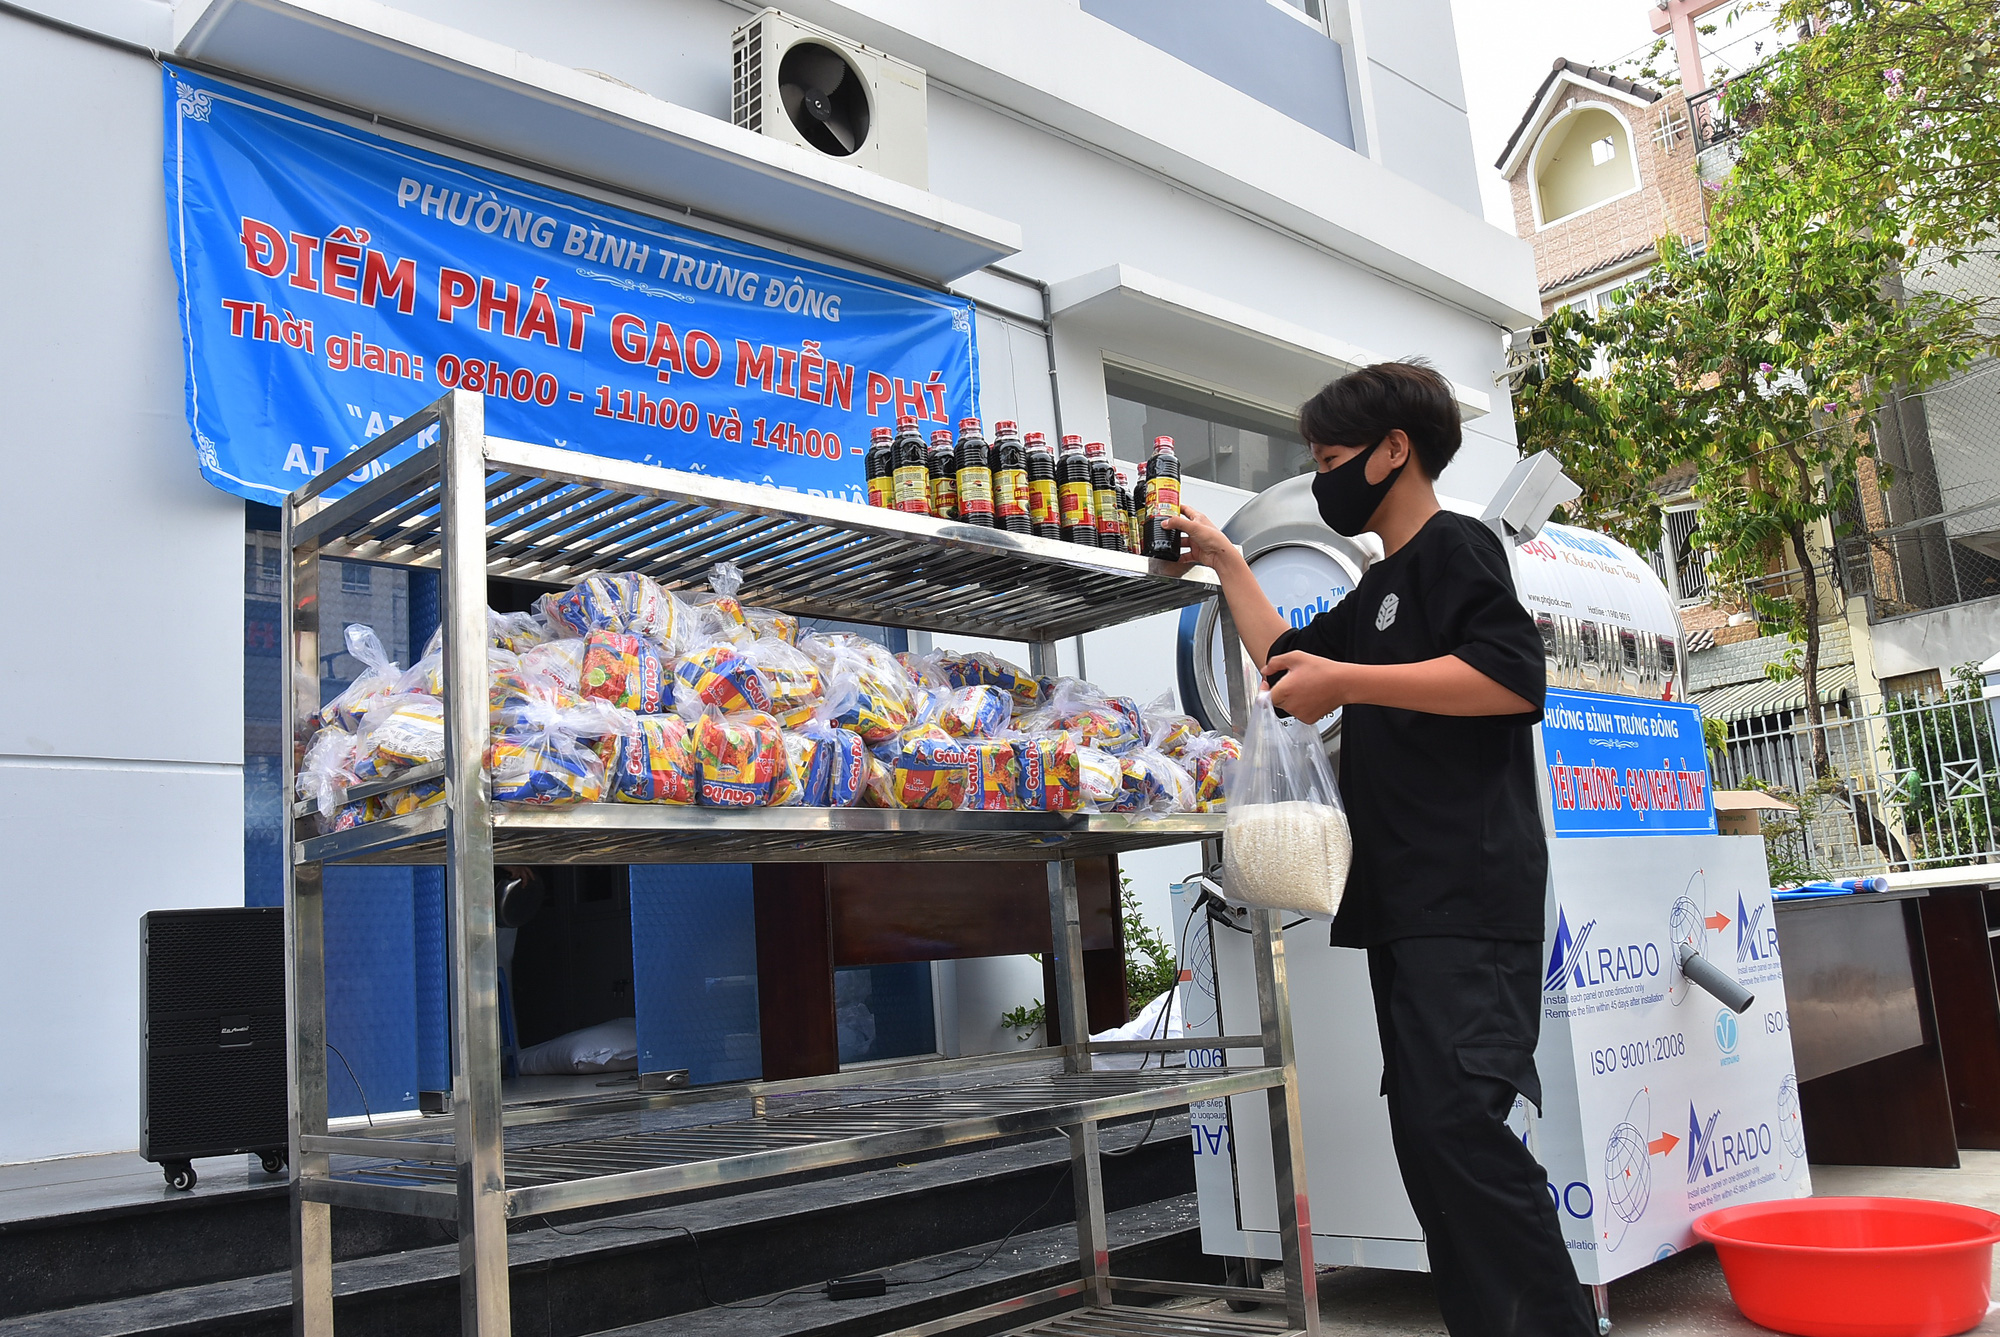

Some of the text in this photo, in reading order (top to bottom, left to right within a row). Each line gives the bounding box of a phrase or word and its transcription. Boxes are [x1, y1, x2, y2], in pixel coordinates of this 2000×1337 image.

[398, 177, 842, 323] PHƯỜNG BÌNH TRƯNG ĐÔNG
[240, 216, 950, 425] ĐIỂM PHÁT GẠO MIỄN PHÍ
[221, 297, 314, 354] Thời
[326, 332, 423, 380] gian:
[436, 354, 558, 408] 08h00
[567, 390, 583, 403] -
[594, 385, 699, 433] 11h00
[706, 407, 743, 444] và
[751, 417, 842, 461] 14h00
[282, 443, 329, 477] AI
[1617, 565, 1641, 583] Tay
[1543, 703, 1679, 739] HƯỜNG BÌNH TRƯNG ĐÔNG
[1551, 750, 1575, 810] YÊU
[1573, 759, 1621, 810] THƯƠNG
[1626, 768, 1650, 822] GẠO
[1647, 758, 1682, 811] NGHĨA
[1543, 983, 1645, 1005] Install each panel on one direction only
[1545, 993, 1665, 1019] Remove the film within 45 days after installation
[1764, 1011, 1783, 1034] ISO
[1590, 1032, 1686, 1076] ISO 9001:2008
